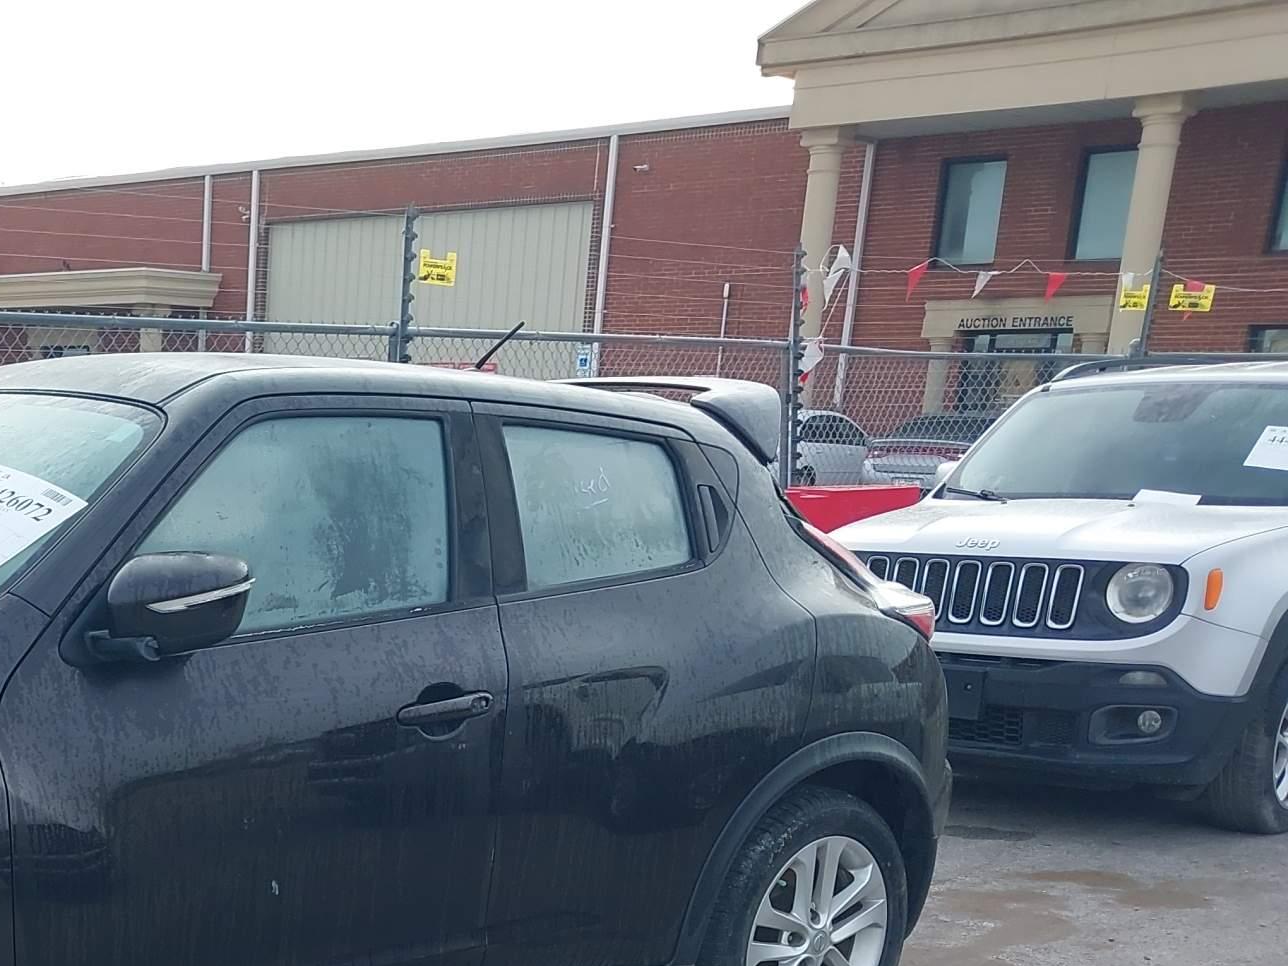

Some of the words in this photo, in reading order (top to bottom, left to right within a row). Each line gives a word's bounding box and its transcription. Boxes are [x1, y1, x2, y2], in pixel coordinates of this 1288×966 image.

[958, 317, 1007, 329] AUCTION
[1011, 316, 1074, 328] ENTRANCE
[955, 536, 1001, 551] Jeep
